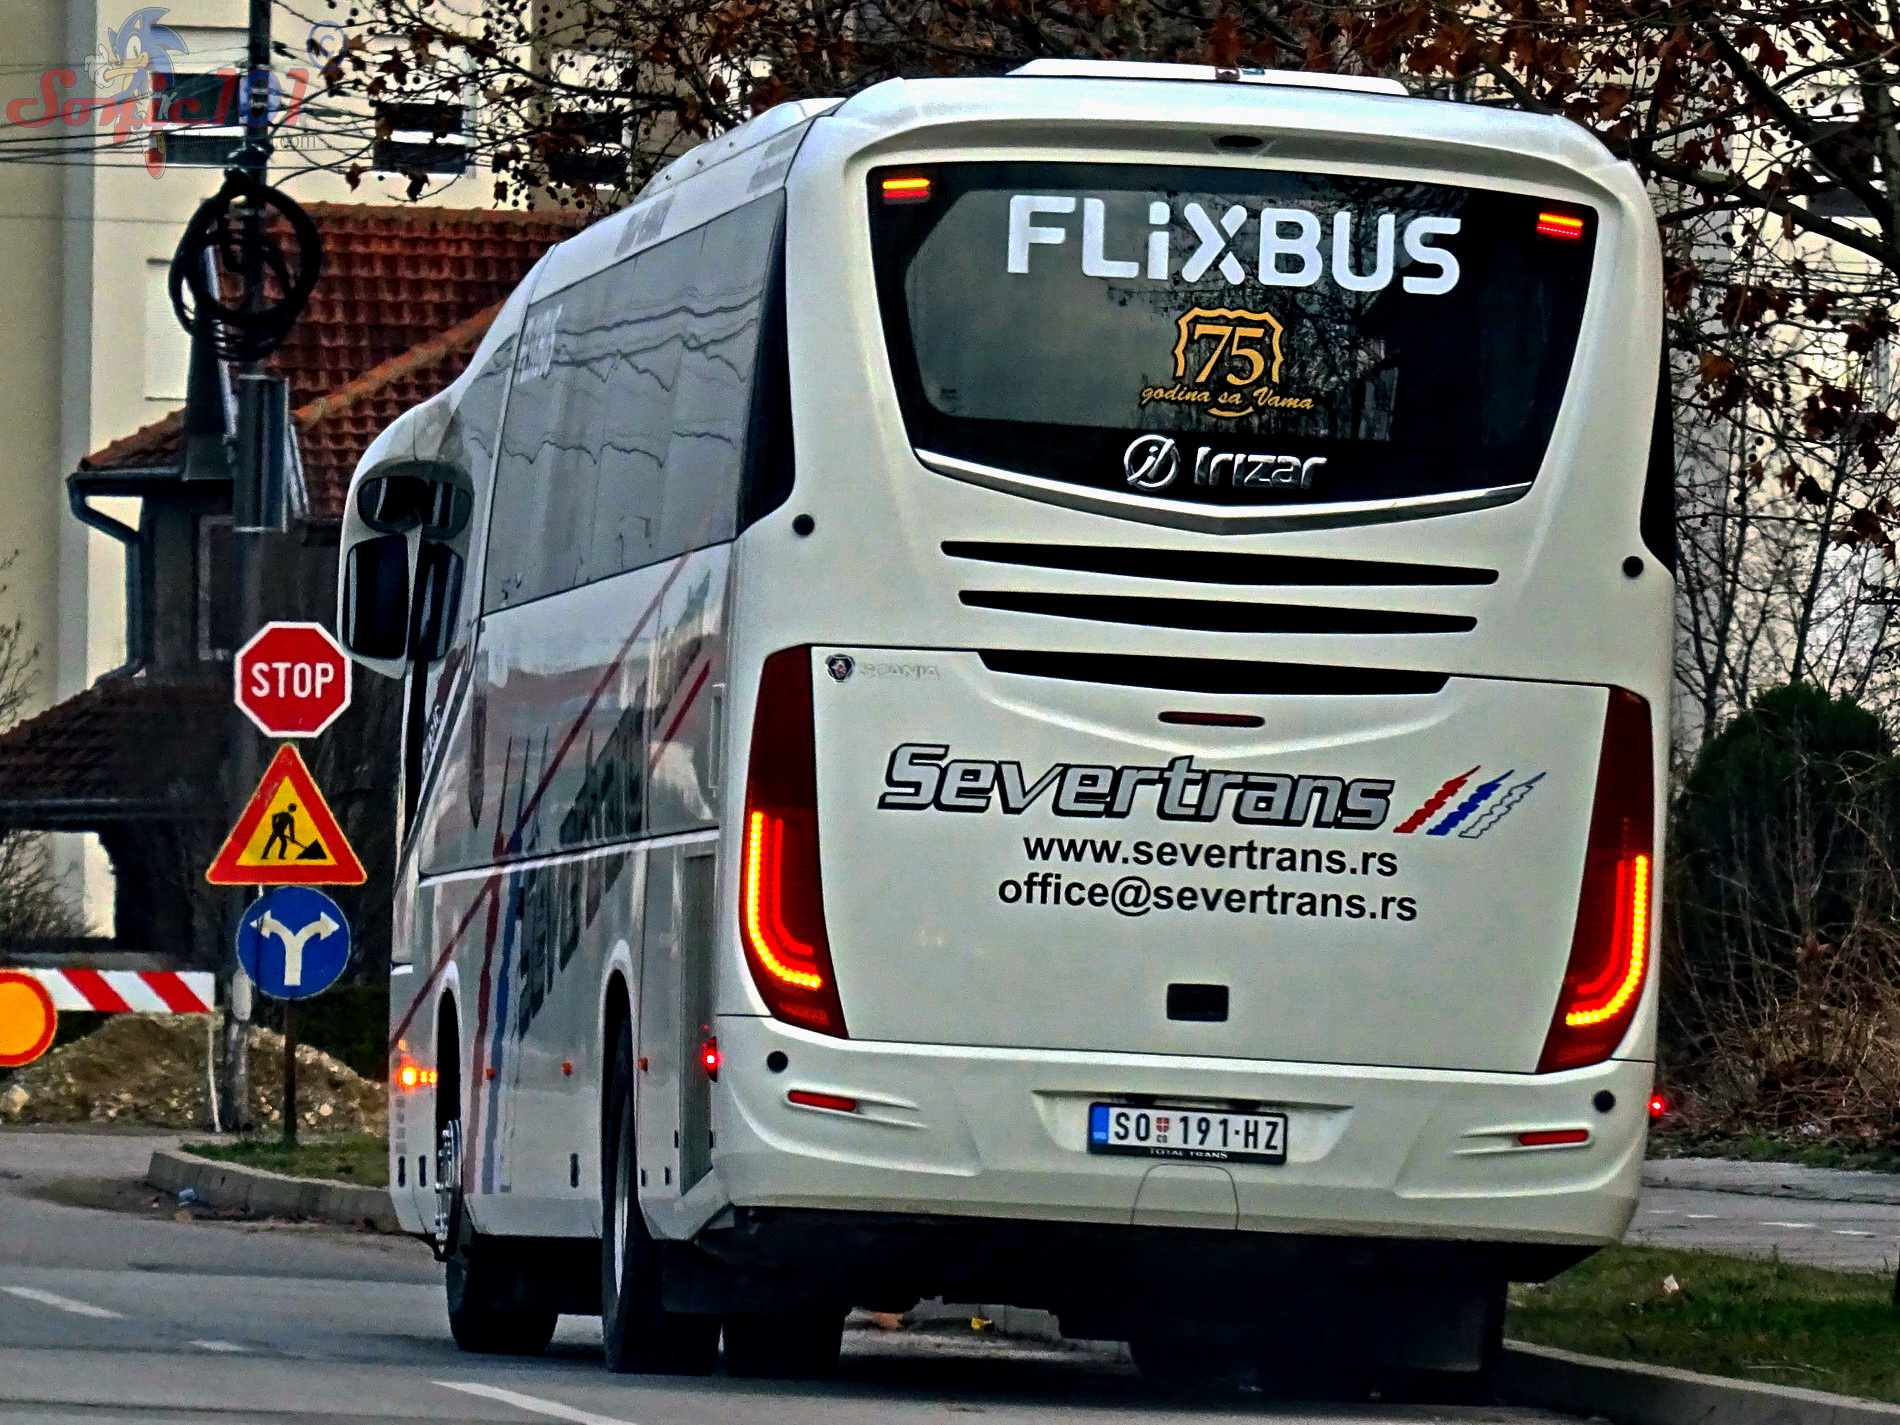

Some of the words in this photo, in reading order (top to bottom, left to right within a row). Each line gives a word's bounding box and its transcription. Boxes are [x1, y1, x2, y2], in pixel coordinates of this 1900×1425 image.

[1193, 323, 1265, 386] 75
[1140, 383, 1211, 405] godina
[1217, 390, 1242, 405] sa
[1253, 386, 1315, 410] Vama
[1194, 446, 1328, 489] Irizar
[251, 661, 335, 700] STOP
[878, 742, 1395, 830] Severtrans
[1024, 834, 1398, 877] www.severtrans.rs
[998, 874, 1417, 922] office@severtrans.rs
[1114, 1112, 1150, 1142] SO
[1189, 1151, 1228, 1160] TRANS
